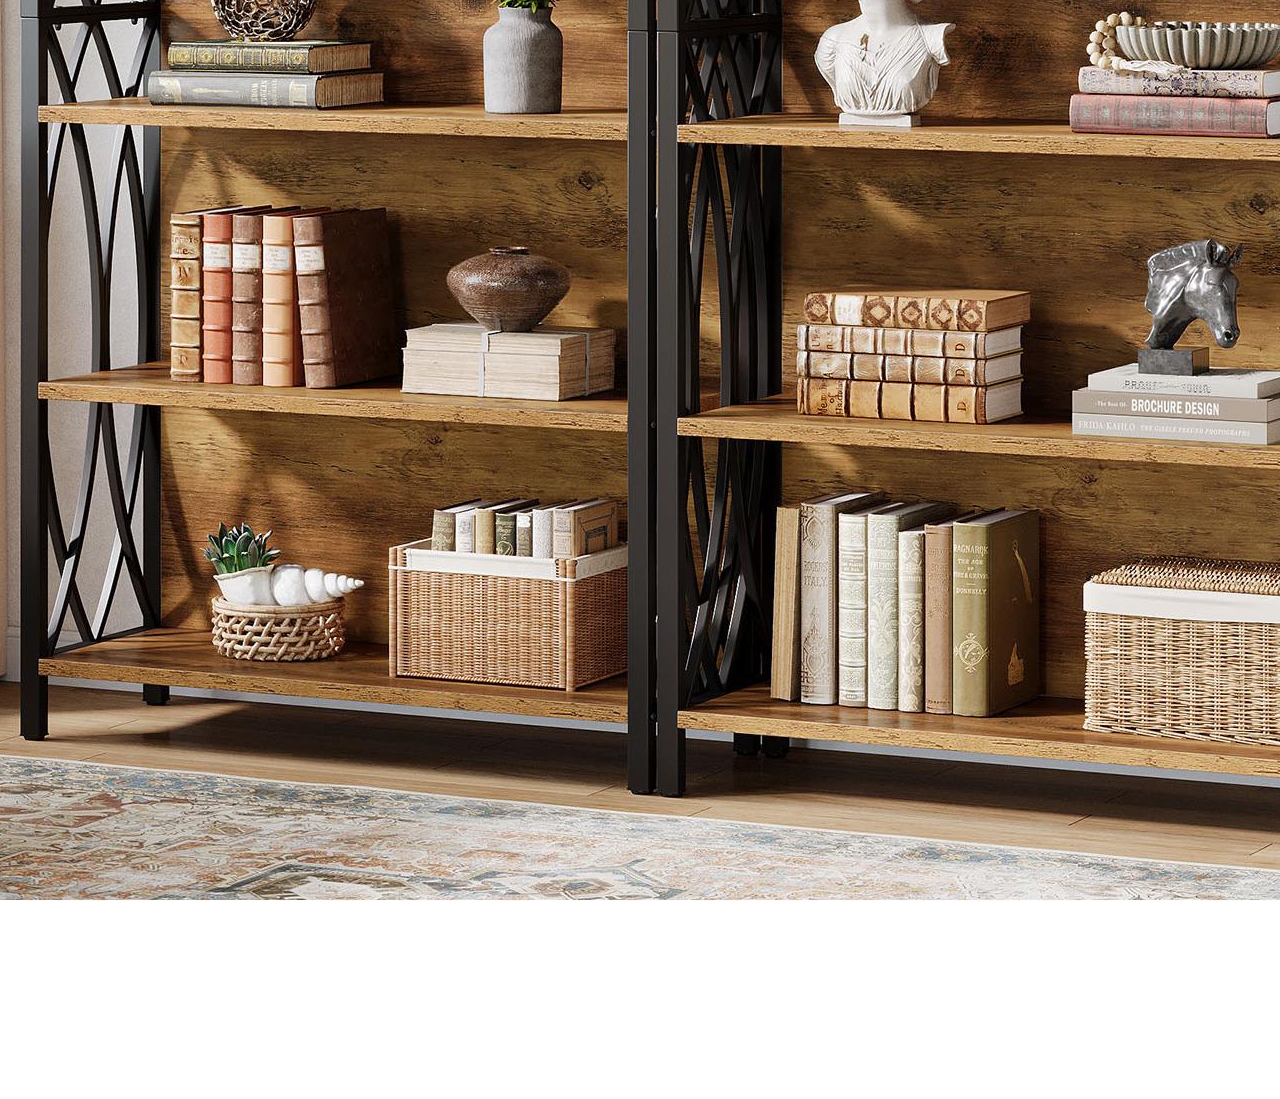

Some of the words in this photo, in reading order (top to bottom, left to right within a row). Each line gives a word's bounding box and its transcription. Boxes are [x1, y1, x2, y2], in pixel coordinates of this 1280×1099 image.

[955, 343, 966, 351] D
[955, 368, 966, 377] D
[957, 401, 967, 411] D
[1131, 398, 1182, 414] BROCHURE
[1185, 401, 1220, 416] DESIGN
